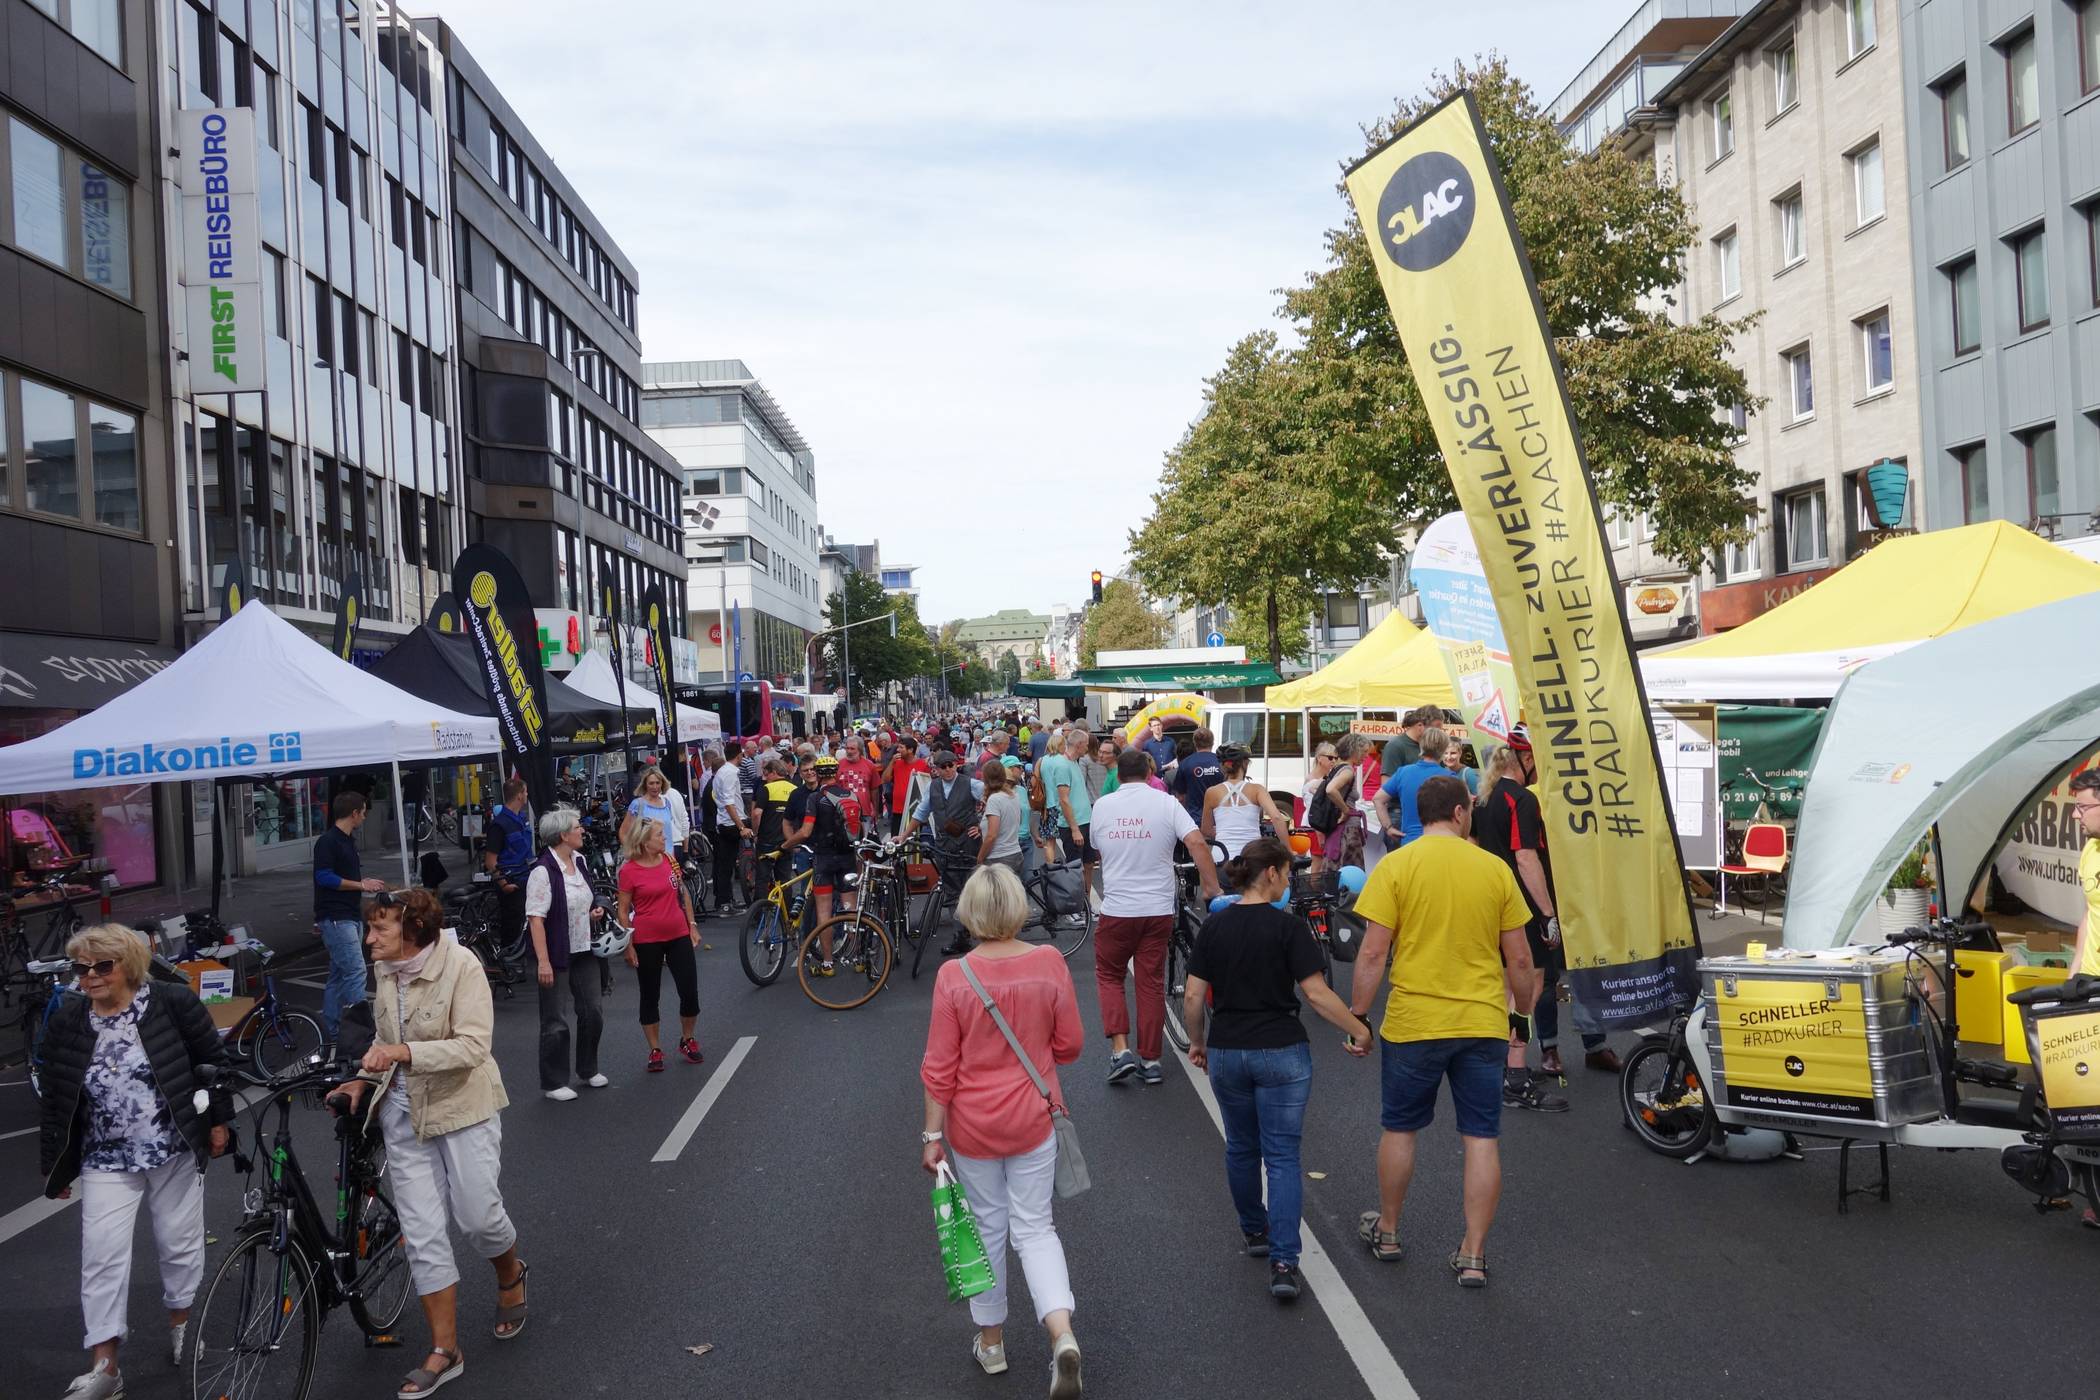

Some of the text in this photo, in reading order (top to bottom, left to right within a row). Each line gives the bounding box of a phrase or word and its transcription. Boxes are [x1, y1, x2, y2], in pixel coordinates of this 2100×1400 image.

[200, 114, 238, 384] FIRST REISEBÜRO
[1429, 323, 1546, 614] ZUVERLÄSSIG.
[1485, 345, 1645, 838] #RADKURIER #AACHEN
[1532, 627, 1598, 835] SCHNELL.
[73, 736, 258, 779] Diakonie
[1203, 765, 1220, 773] adfc
[1765, 769, 1780, 778] und
[1734, 792, 1745, 802] 21
[1748, 792, 1759, 802] 61
[1108, 830, 1152, 840] CATELLA
[1116, 818, 1144, 827] TEAM
[1601, 965, 1676, 990] Kuriertransporte
[1611, 980, 1675, 1003] online buchen:
[1739, 1000, 1836, 1027] SCHNELLER.
[1743, 1019, 1843, 1048] #RADKURIER
[1740, 1093, 1758, 1102] Kurier
[1760, 1095, 1777, 1104] online
[1778, 1096, 1801, 1106] buchen:
